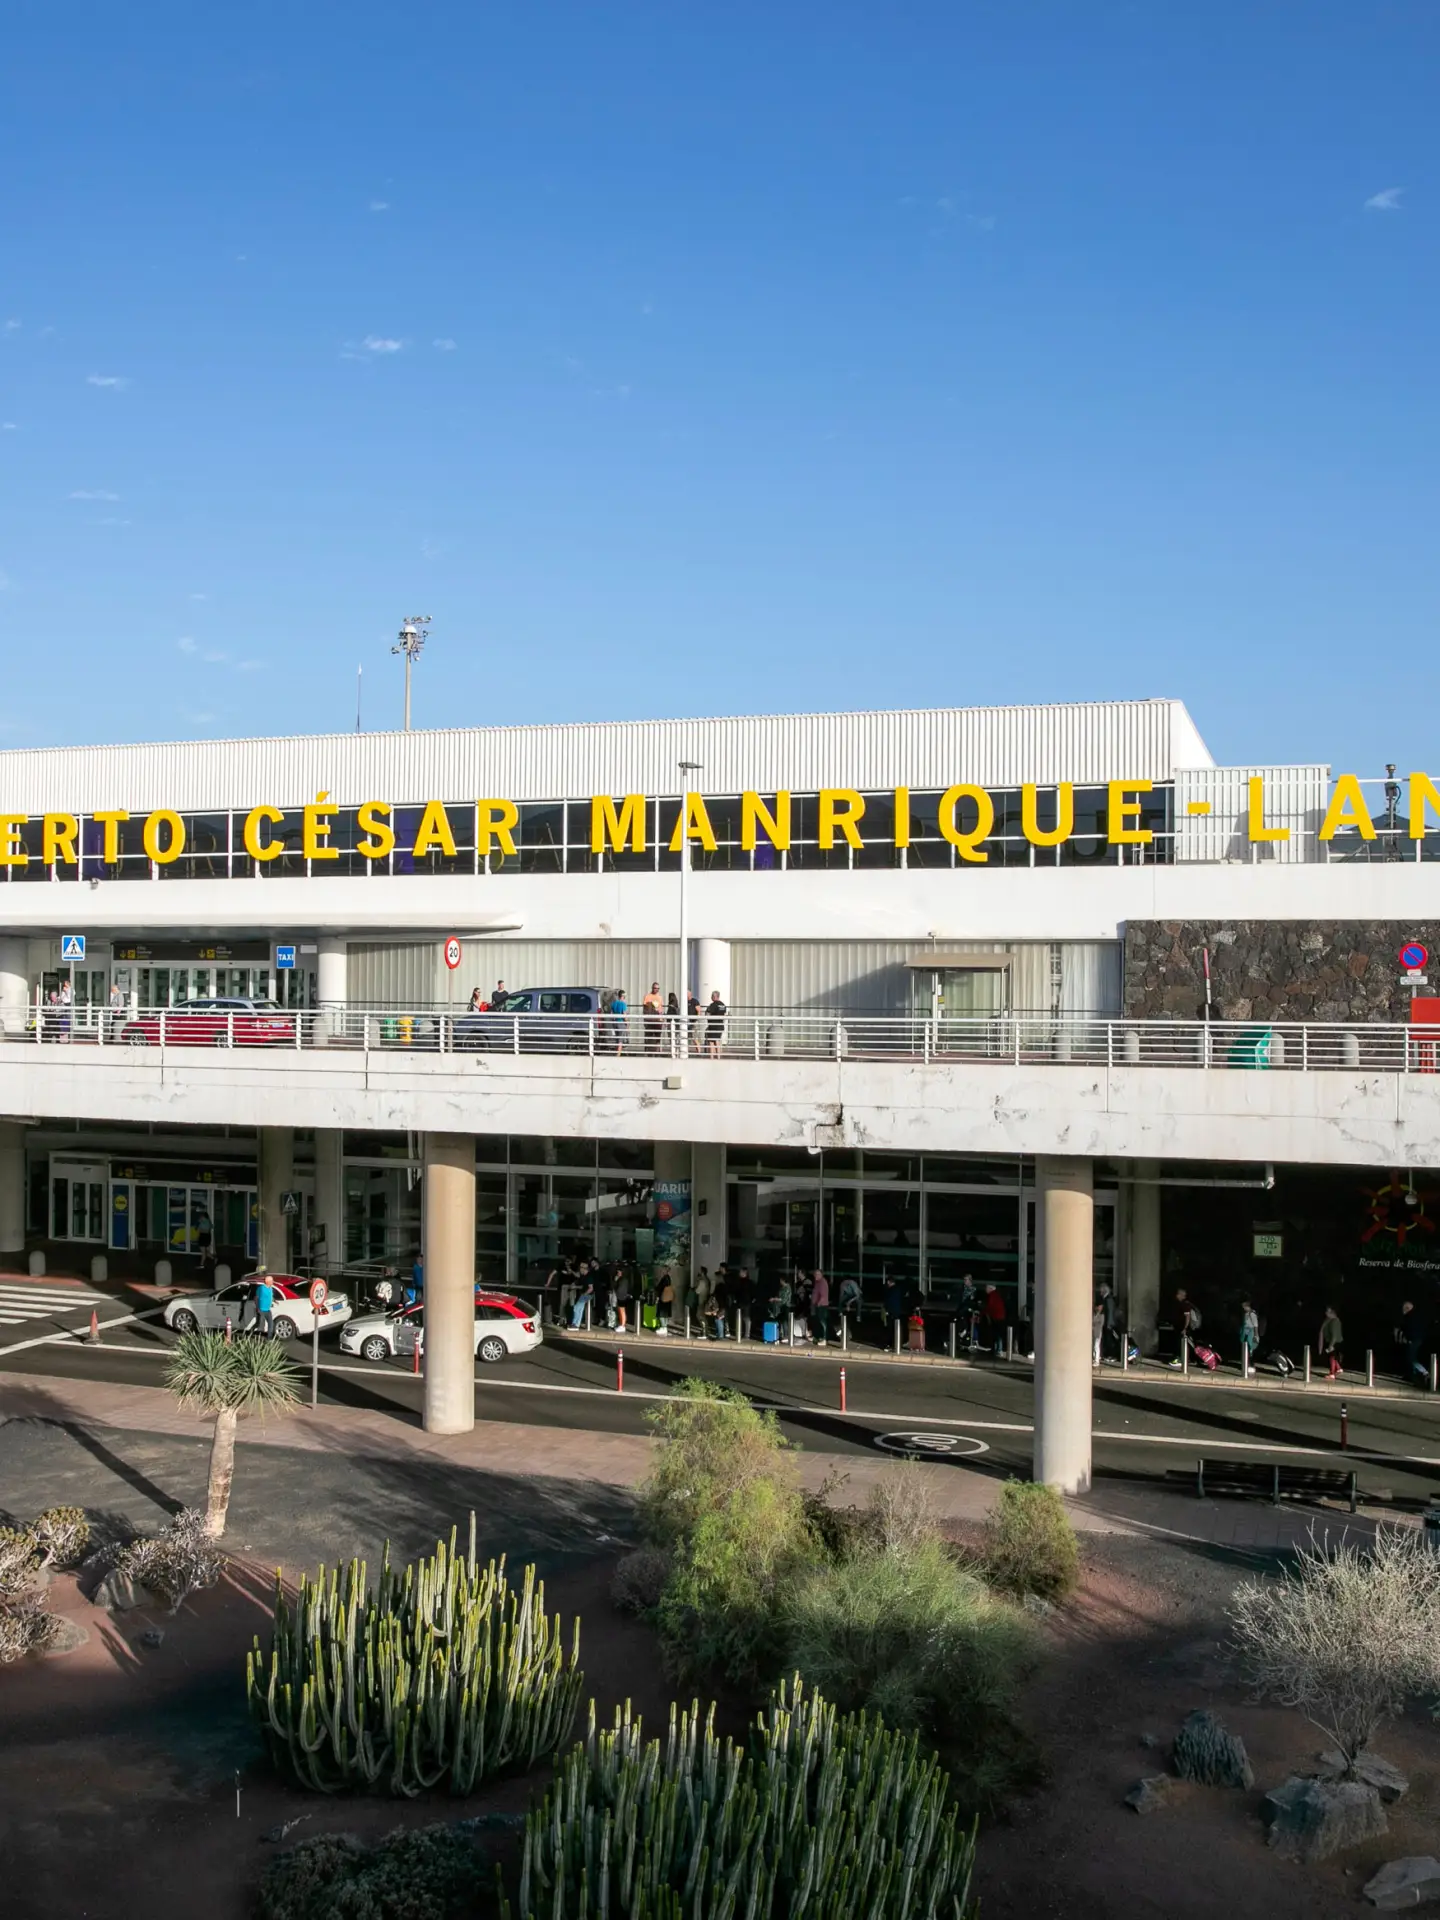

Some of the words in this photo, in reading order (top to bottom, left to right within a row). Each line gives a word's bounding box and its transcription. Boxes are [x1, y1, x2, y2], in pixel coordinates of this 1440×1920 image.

[0, 808, 186, 867] ERTO
[243, 791, 519, 862] CÉSAR
[589, 779, 1154, 863] MANRIQUE
[278, 953, 295, 961] TAXI
[450, 947, 458, 957] 20
[1359, 1257, 1391, 1268] Reserva
[1393, 1258, 1404, 1268] de
[1406, 1259, 1440, 1271] Biosfera
[315, 1288, 324, 1299] 20
